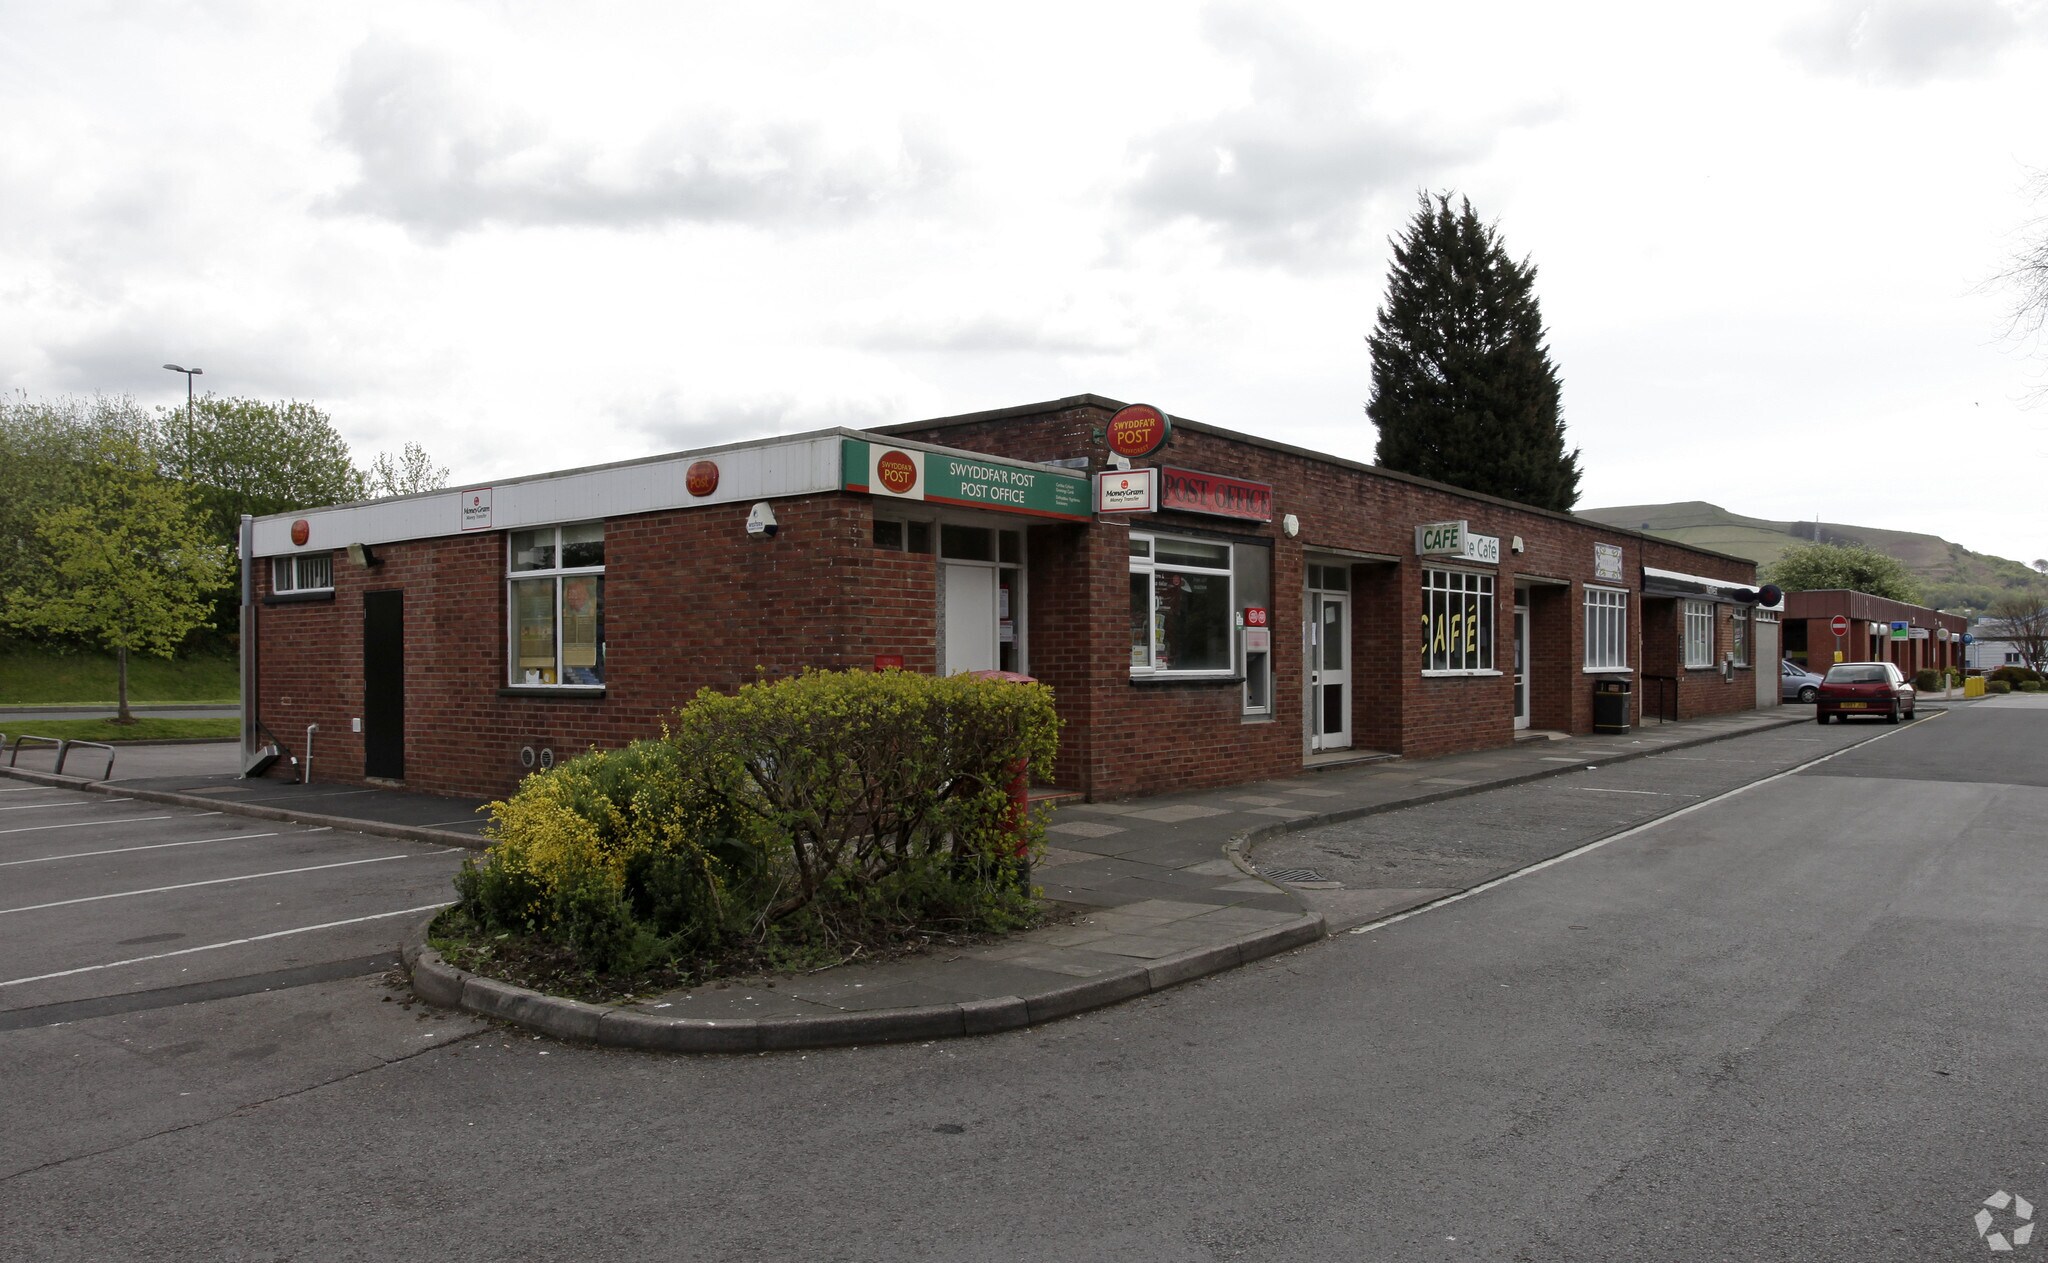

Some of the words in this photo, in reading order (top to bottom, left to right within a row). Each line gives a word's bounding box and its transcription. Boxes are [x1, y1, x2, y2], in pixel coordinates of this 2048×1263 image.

[1114, 419, 1155, 430] SWYDDFA'R
[1117, 428, 1151, 446] POST
[881, 461, 913, 472] SWYDDFA'R
[949, 462, 1009, 484] SWYDDFA'R
[1010, 472, 1035, 488] POST
[884, 469, 910, 484] POST
[961, 482, 988, 498] POST
[990, 486, 1025, 504] OFFICE
[1105, 489, 1144, 497] MoneyGram
[1163, 474, 1209, 506] POST
[1214, 483, 1271, 515] OFFICE
[1477, 537, 1497, 560] Café
